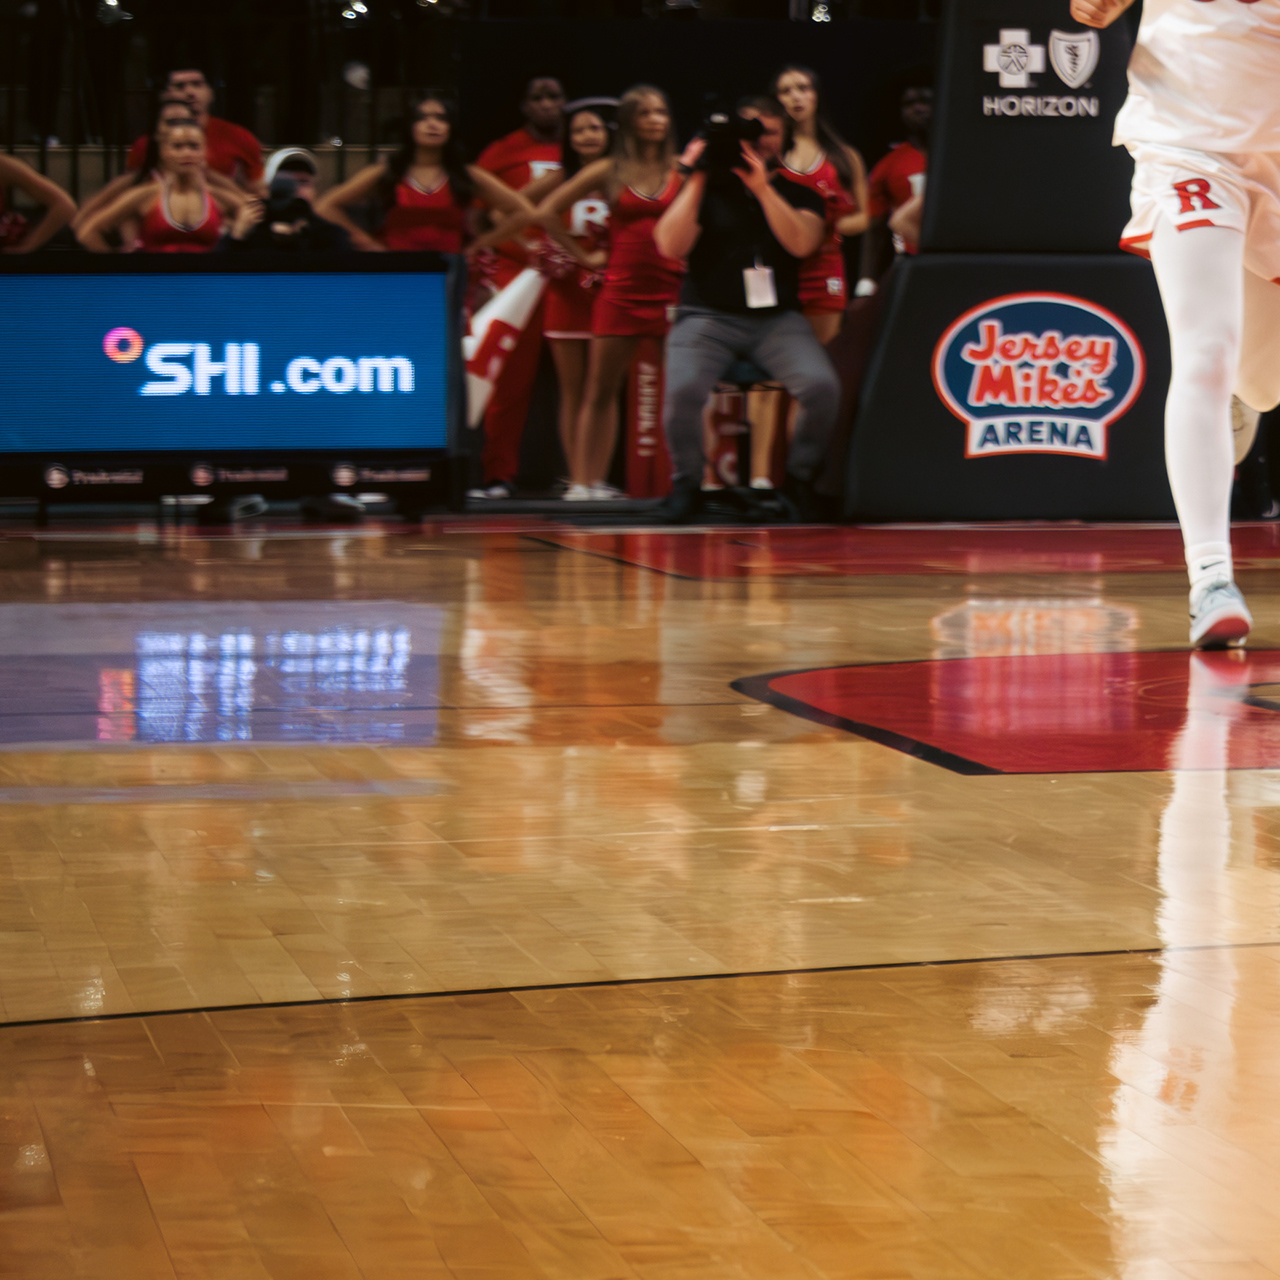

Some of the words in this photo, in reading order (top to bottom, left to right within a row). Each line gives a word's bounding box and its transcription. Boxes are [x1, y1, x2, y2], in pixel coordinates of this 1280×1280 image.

[983, 94, 1099, 117] HORIZON
[1173, 177, 1222, 214] R
[962, 321, 1116, 376] Jersey
[969, 362, 1112, 408] Mike's
[978, 420, 1095, 452] ARENA
